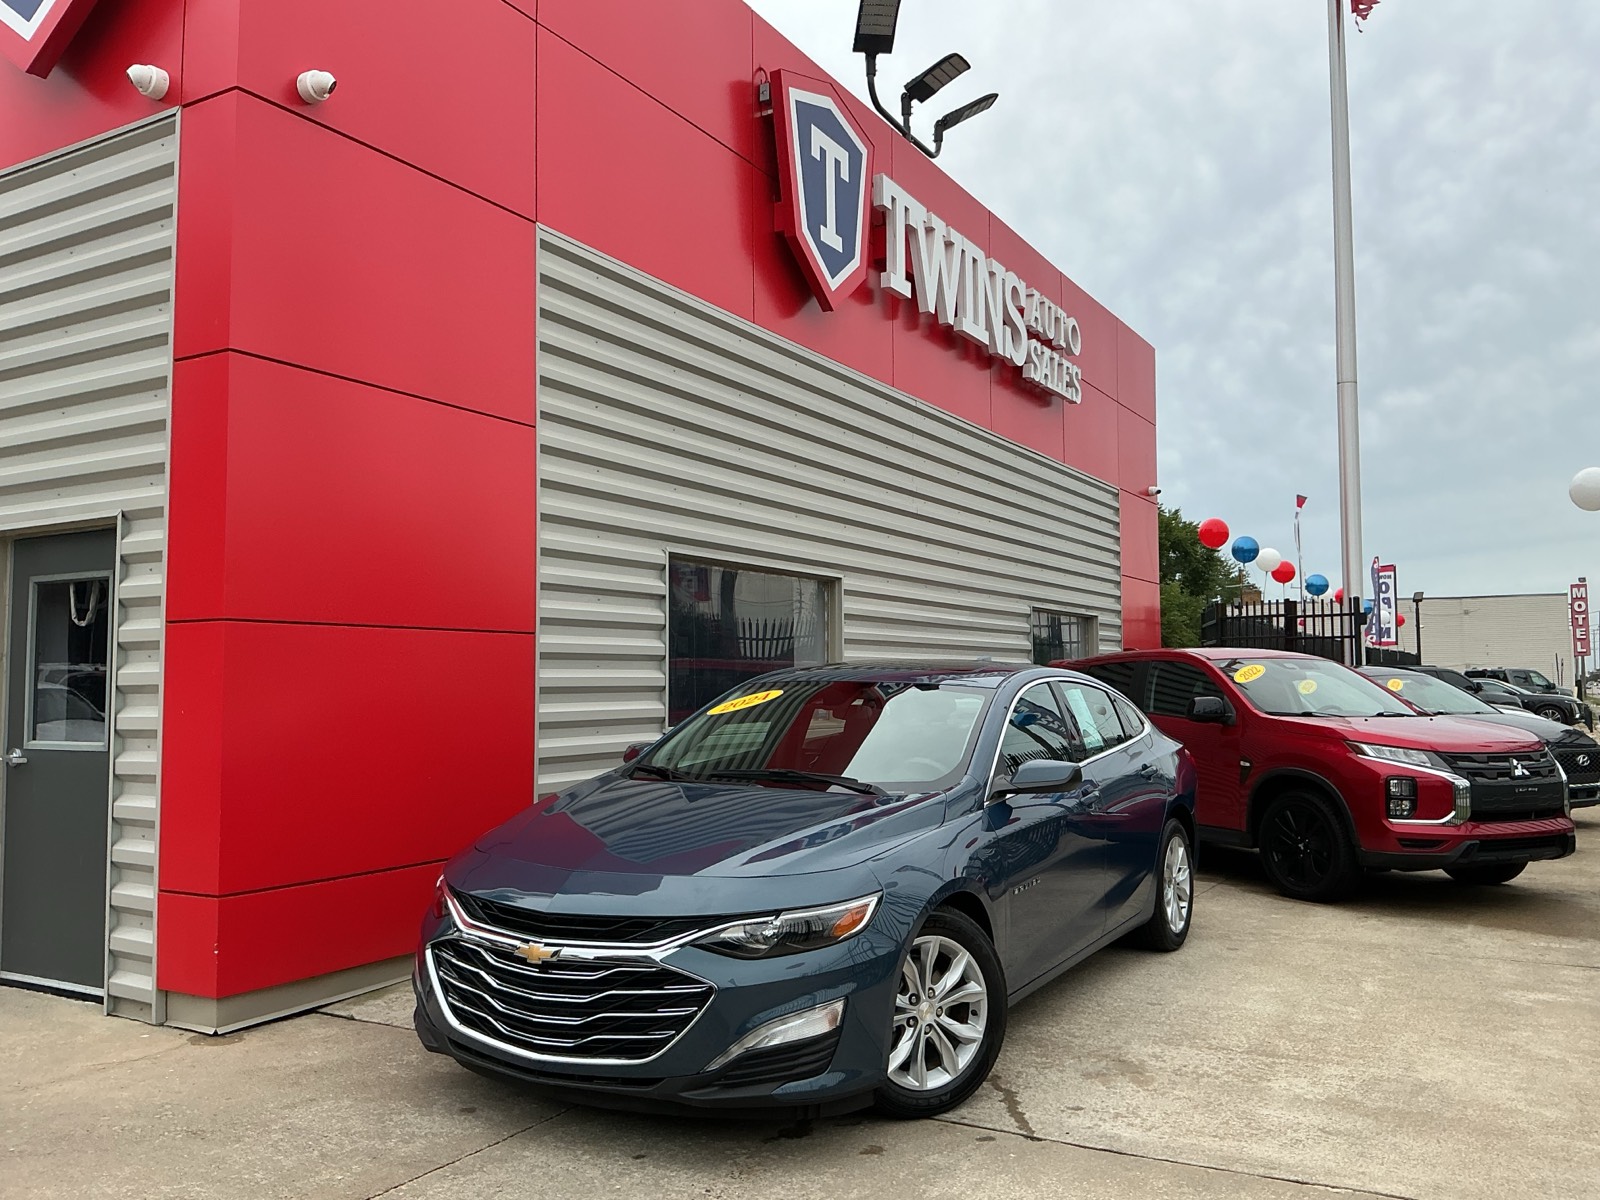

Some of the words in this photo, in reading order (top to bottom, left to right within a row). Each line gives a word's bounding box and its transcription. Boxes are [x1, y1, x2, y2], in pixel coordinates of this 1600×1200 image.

[811, 123, 850, 253] T
[874, 173, 1028, 366] TWINS
[1025, 288, 1081, 356] AUTO
[1023, 339, 1081, 404] SALES
[1572, 587, 1586, 652] MOTEL
[719, 692, 771, 712] 2024
[1240, 666, 1261, 681] 2022
